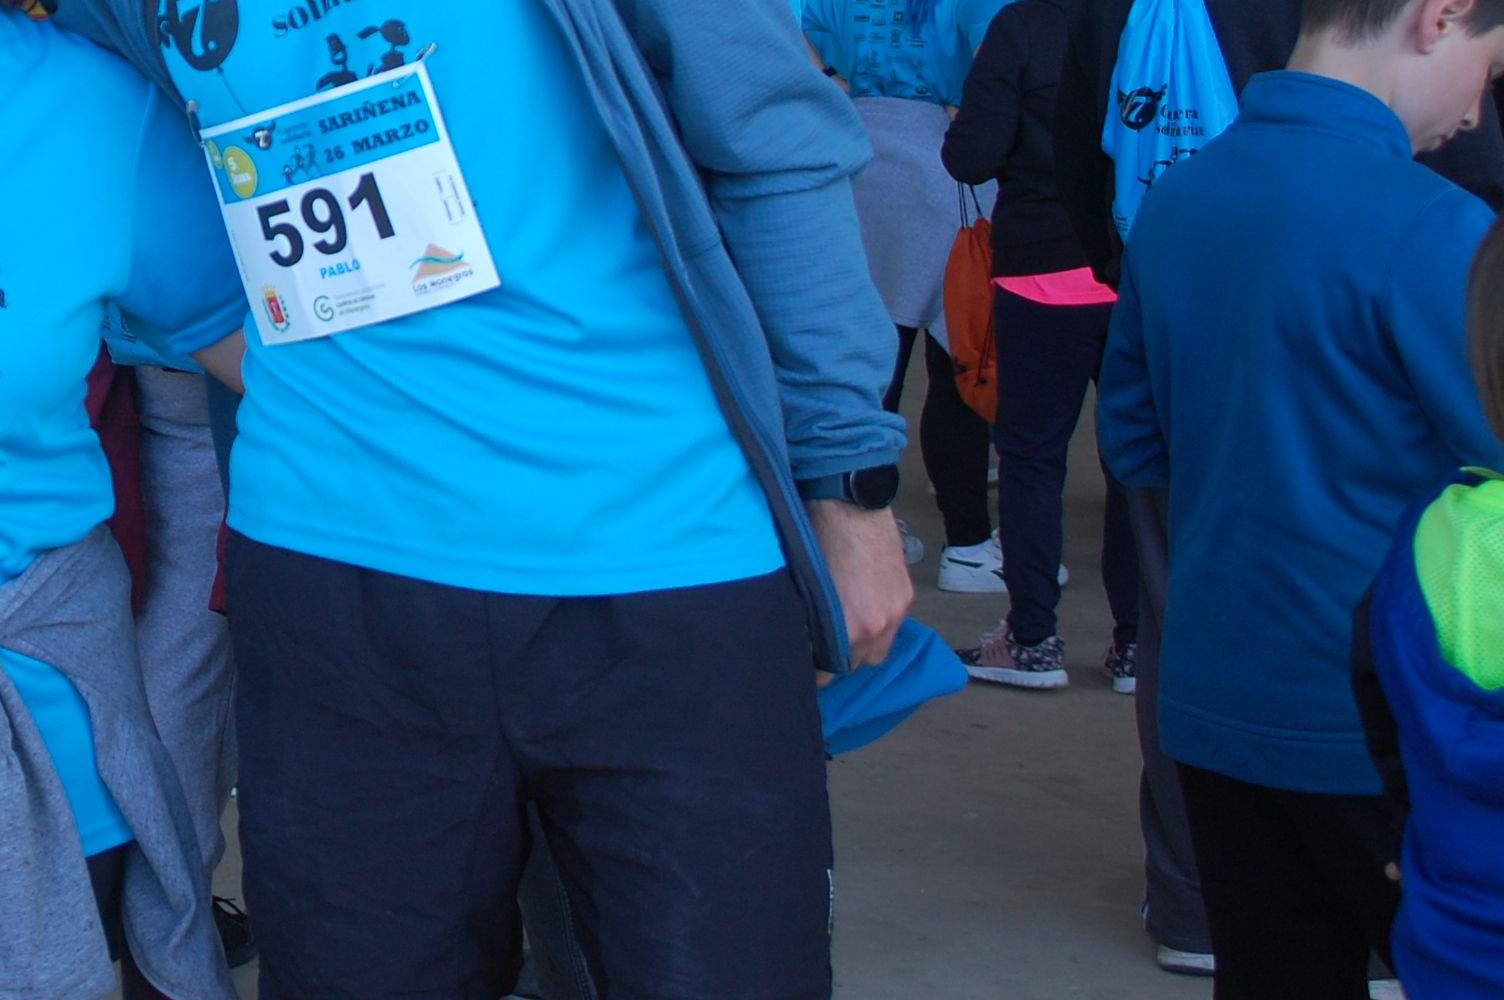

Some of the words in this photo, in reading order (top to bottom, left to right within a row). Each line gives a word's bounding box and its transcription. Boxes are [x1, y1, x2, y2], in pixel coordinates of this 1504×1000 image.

[318, 91, 422, 134] SARIÑENA
[324, 146, 345, 164] 26
[352, 118, 429, 154] MARZO
[257, 172, 395, 268] 591
[319, 260, 361, 280] PABLO
